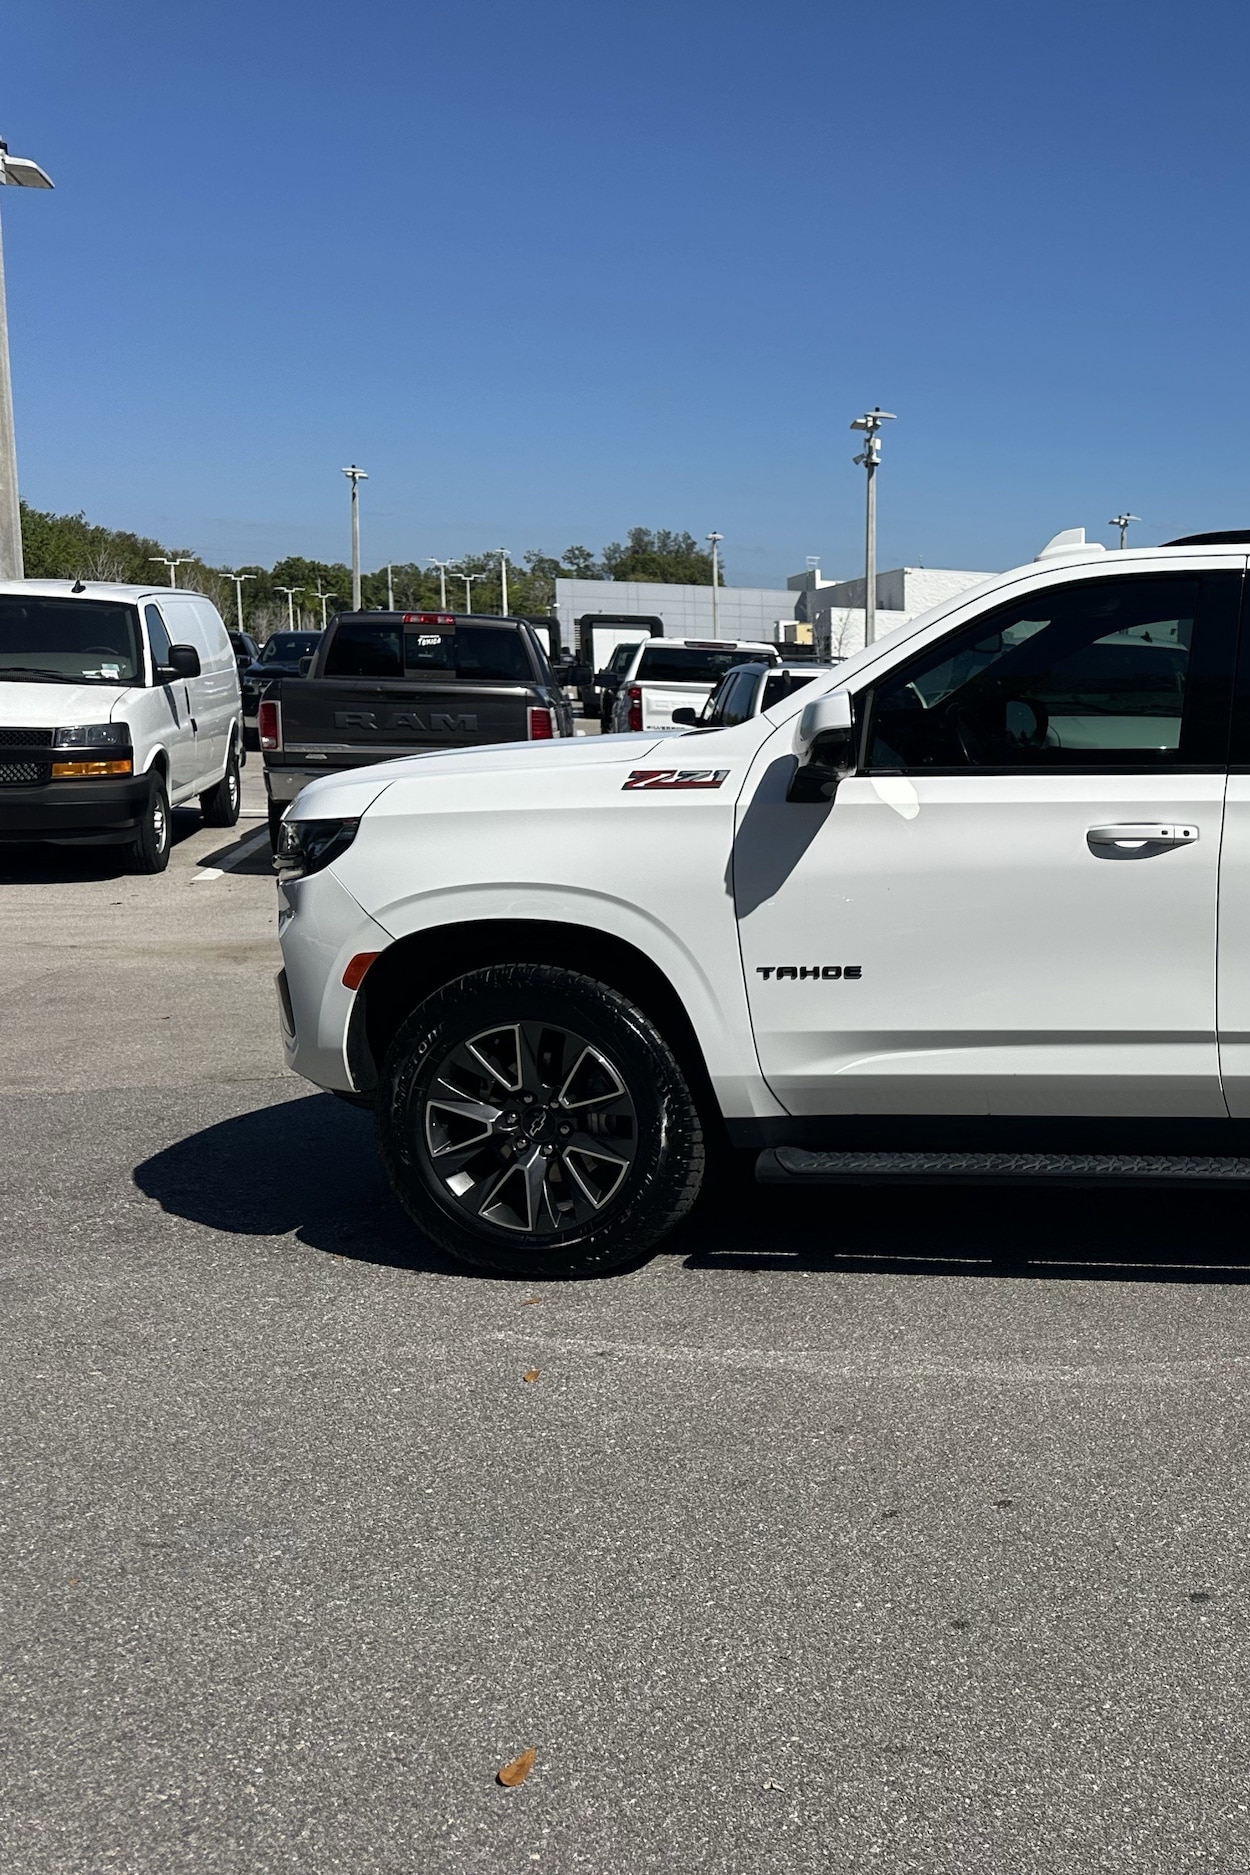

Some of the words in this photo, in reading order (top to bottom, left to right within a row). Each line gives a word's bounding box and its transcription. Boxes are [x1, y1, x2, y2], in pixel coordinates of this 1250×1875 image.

[334, 711, 478, 732] RAM
[621, 769, 731, 790] Z71
[756, 965, 863, 981] TAHOE
